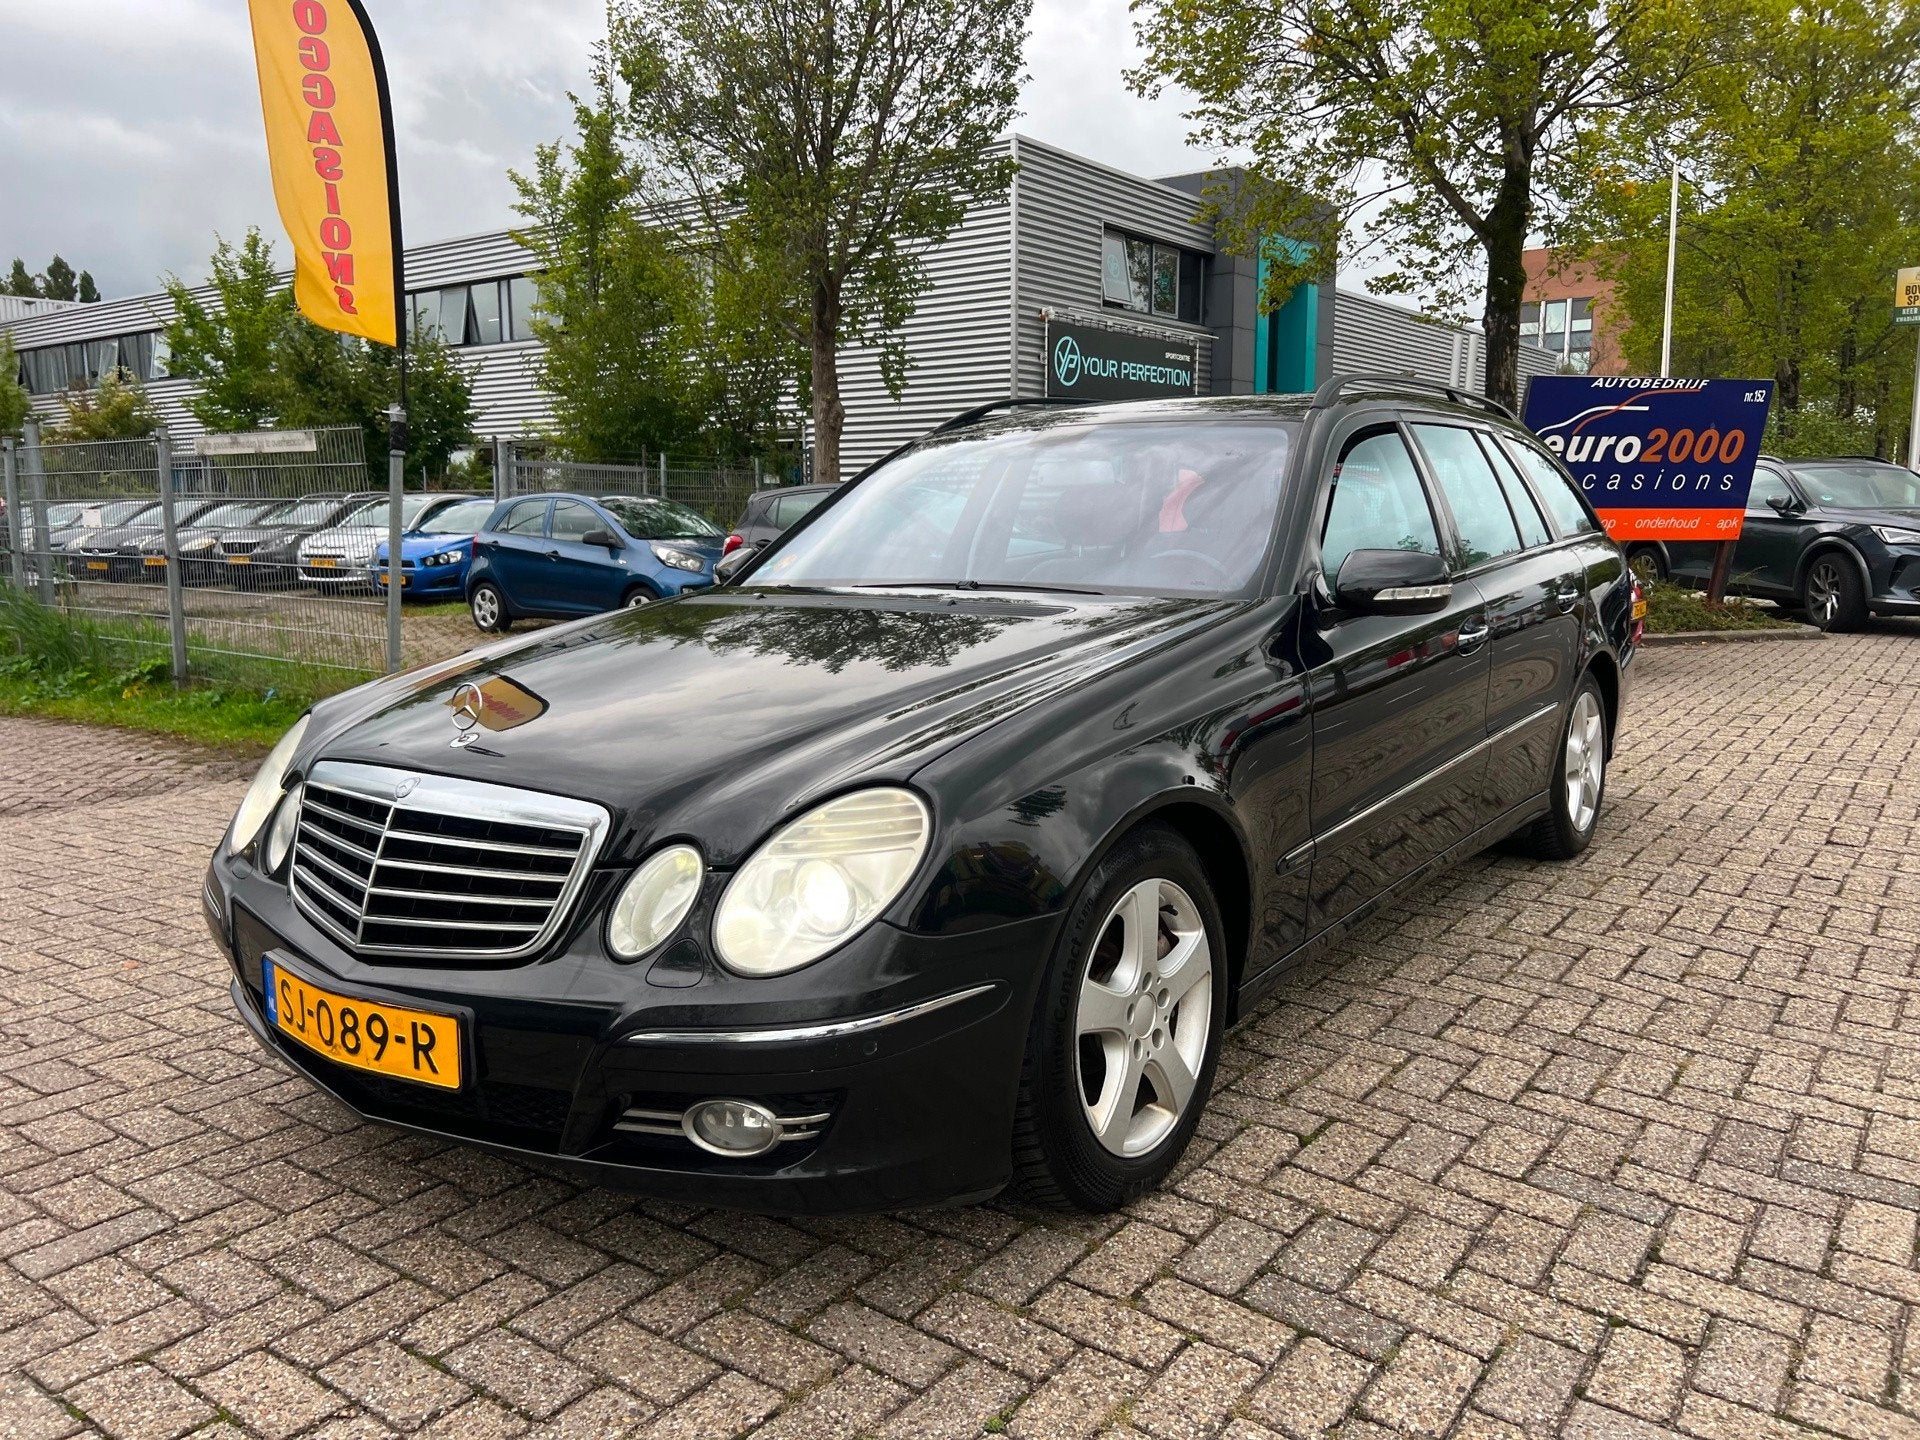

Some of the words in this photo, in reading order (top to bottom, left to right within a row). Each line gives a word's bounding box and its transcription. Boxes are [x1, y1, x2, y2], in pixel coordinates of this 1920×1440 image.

[1165, 352, 1191, 362] SPORTCENTRE
[1081, 355, 1118, 379] YOUR
[1121, 361, 1191, 387] PERFECTION
[1591, 377, 1710, 390] AUTOBEDRIJF
[1743, 389, 1767, 403] nr.152
[1543, 428, 1745, 463] euro2000
[1582, 468, 1734, 490] casions
[1601, 518, 1616, 531] op
[1635, 516, 1701, 529] onderhoud
[1716, 516, 1739, 531] apk
[280, 978, 439, 1074] SJ-089-R
